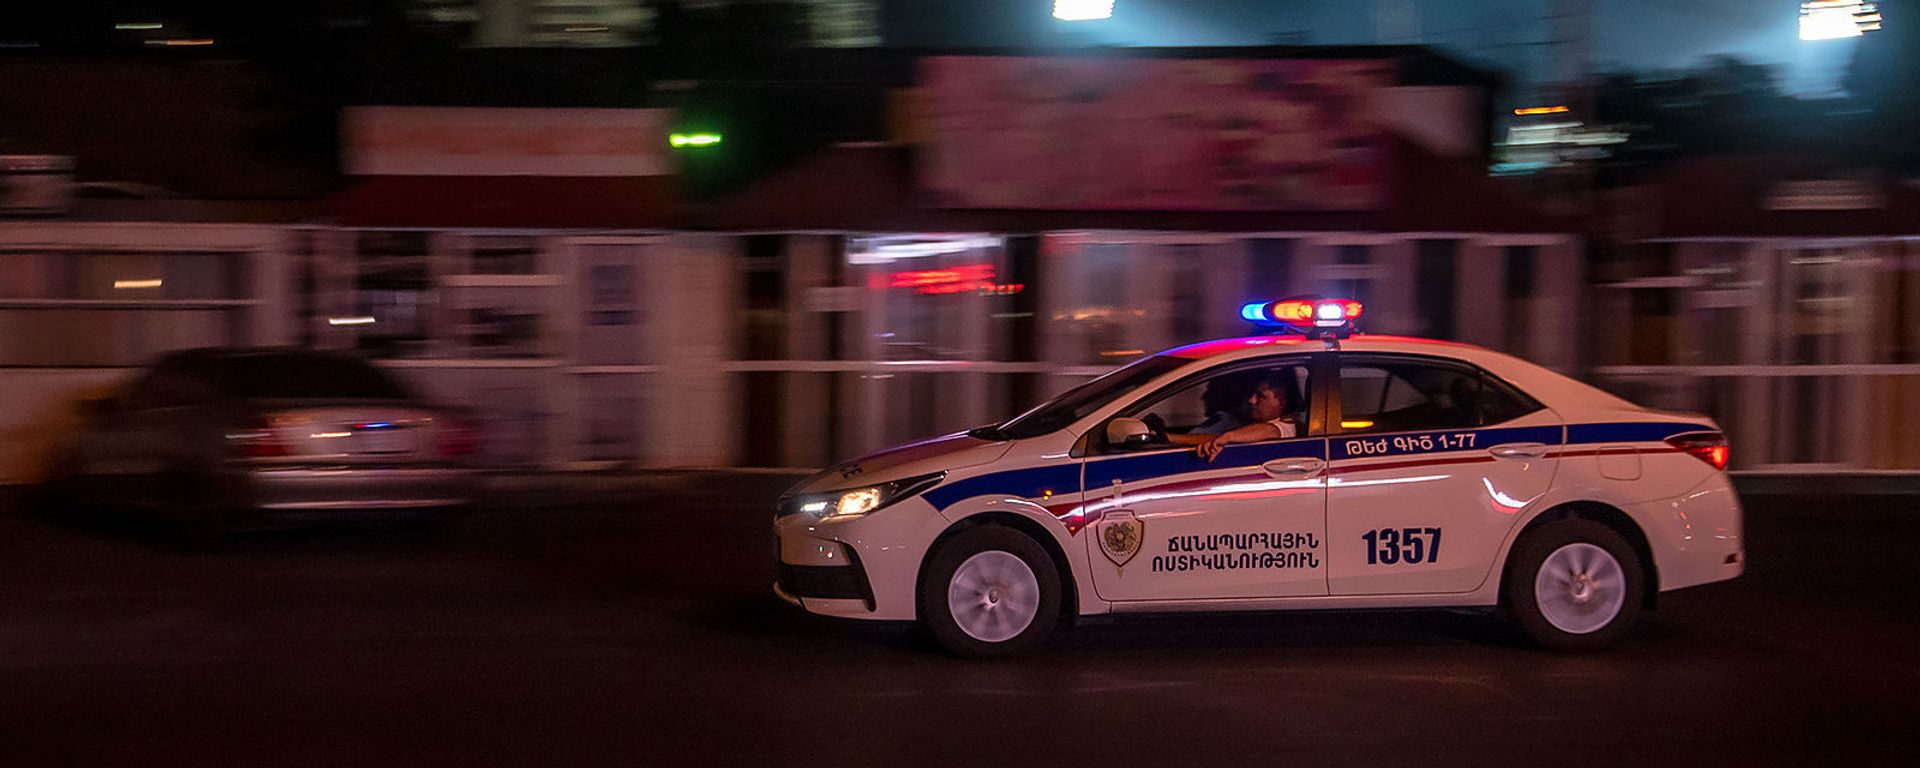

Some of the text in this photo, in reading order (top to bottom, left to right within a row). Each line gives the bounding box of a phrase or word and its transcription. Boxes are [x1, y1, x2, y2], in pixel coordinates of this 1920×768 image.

[1438, 433, 1476, 449] 1-77
[1167, 533, 1319, 552] ՃԱՆԱՊԱՐՀԱՅԻՆ
[1361, 527, 1442, 565] 1357
[1152, 552, 1319, 572] ՈՍՏԻԿԱՆՈՒԹՅՈՒՆ
